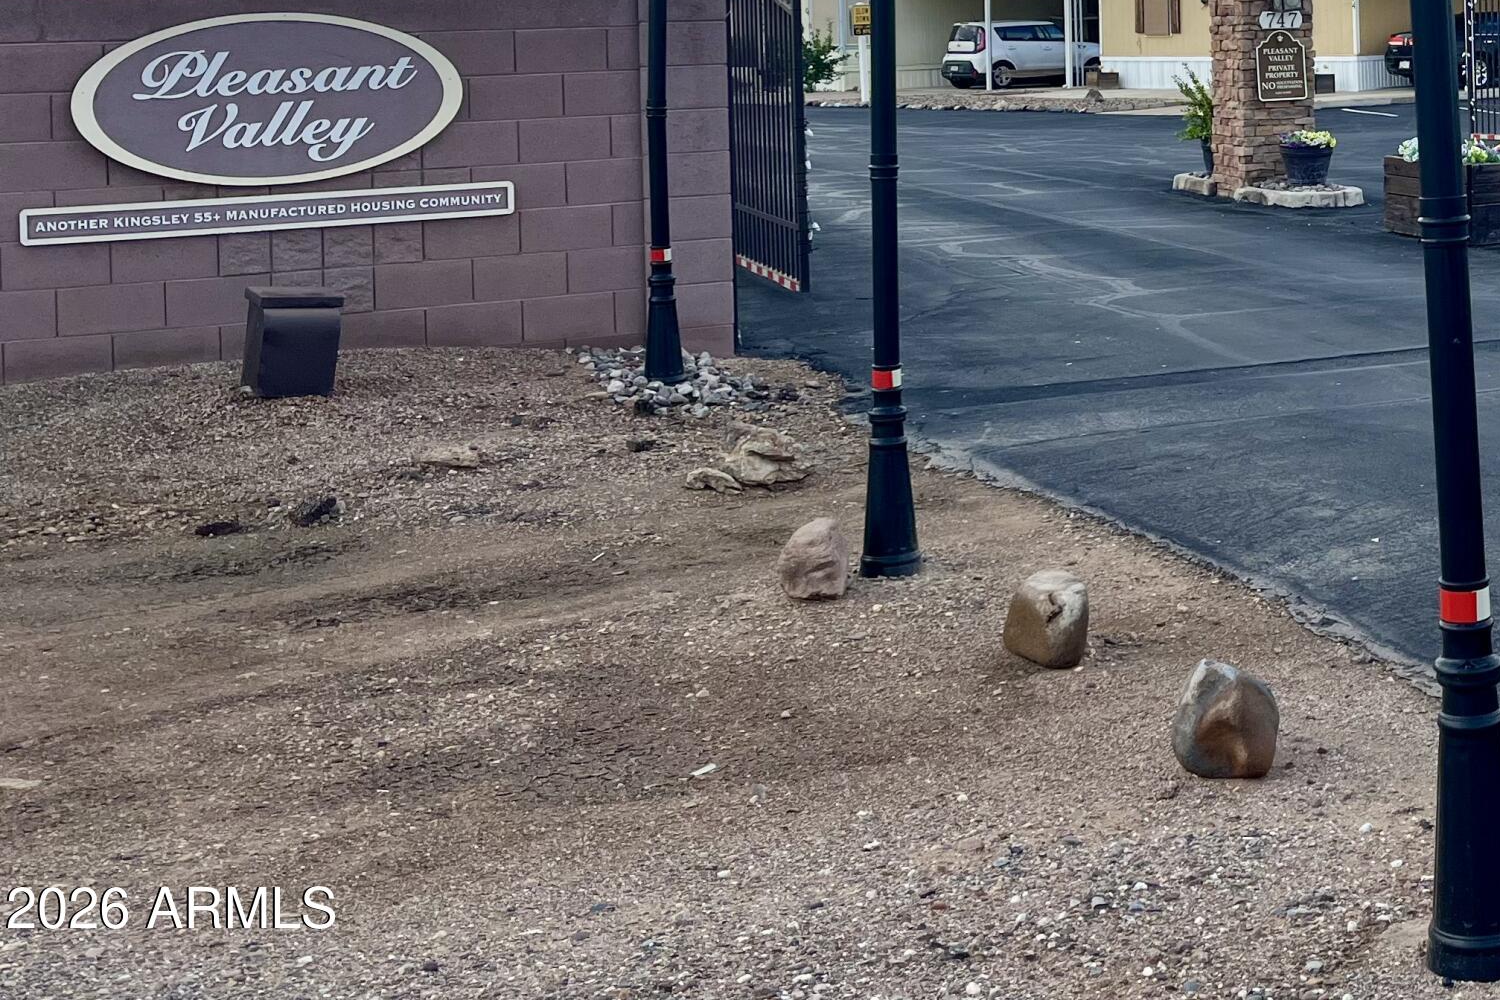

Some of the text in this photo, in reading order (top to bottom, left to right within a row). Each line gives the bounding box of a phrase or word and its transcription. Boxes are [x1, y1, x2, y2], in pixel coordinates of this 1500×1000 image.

[1267, 13, 1298, 28] 747
[132, 49, 418, 100] Pleasant
[1262, 82, 1276, 90] NO
[177, 101, 375, 162] Valley
[35, 193, 503, 233] ANOTHER KINGSLEY 55+ MANUFACTURED HOUSING COMMUNITY
